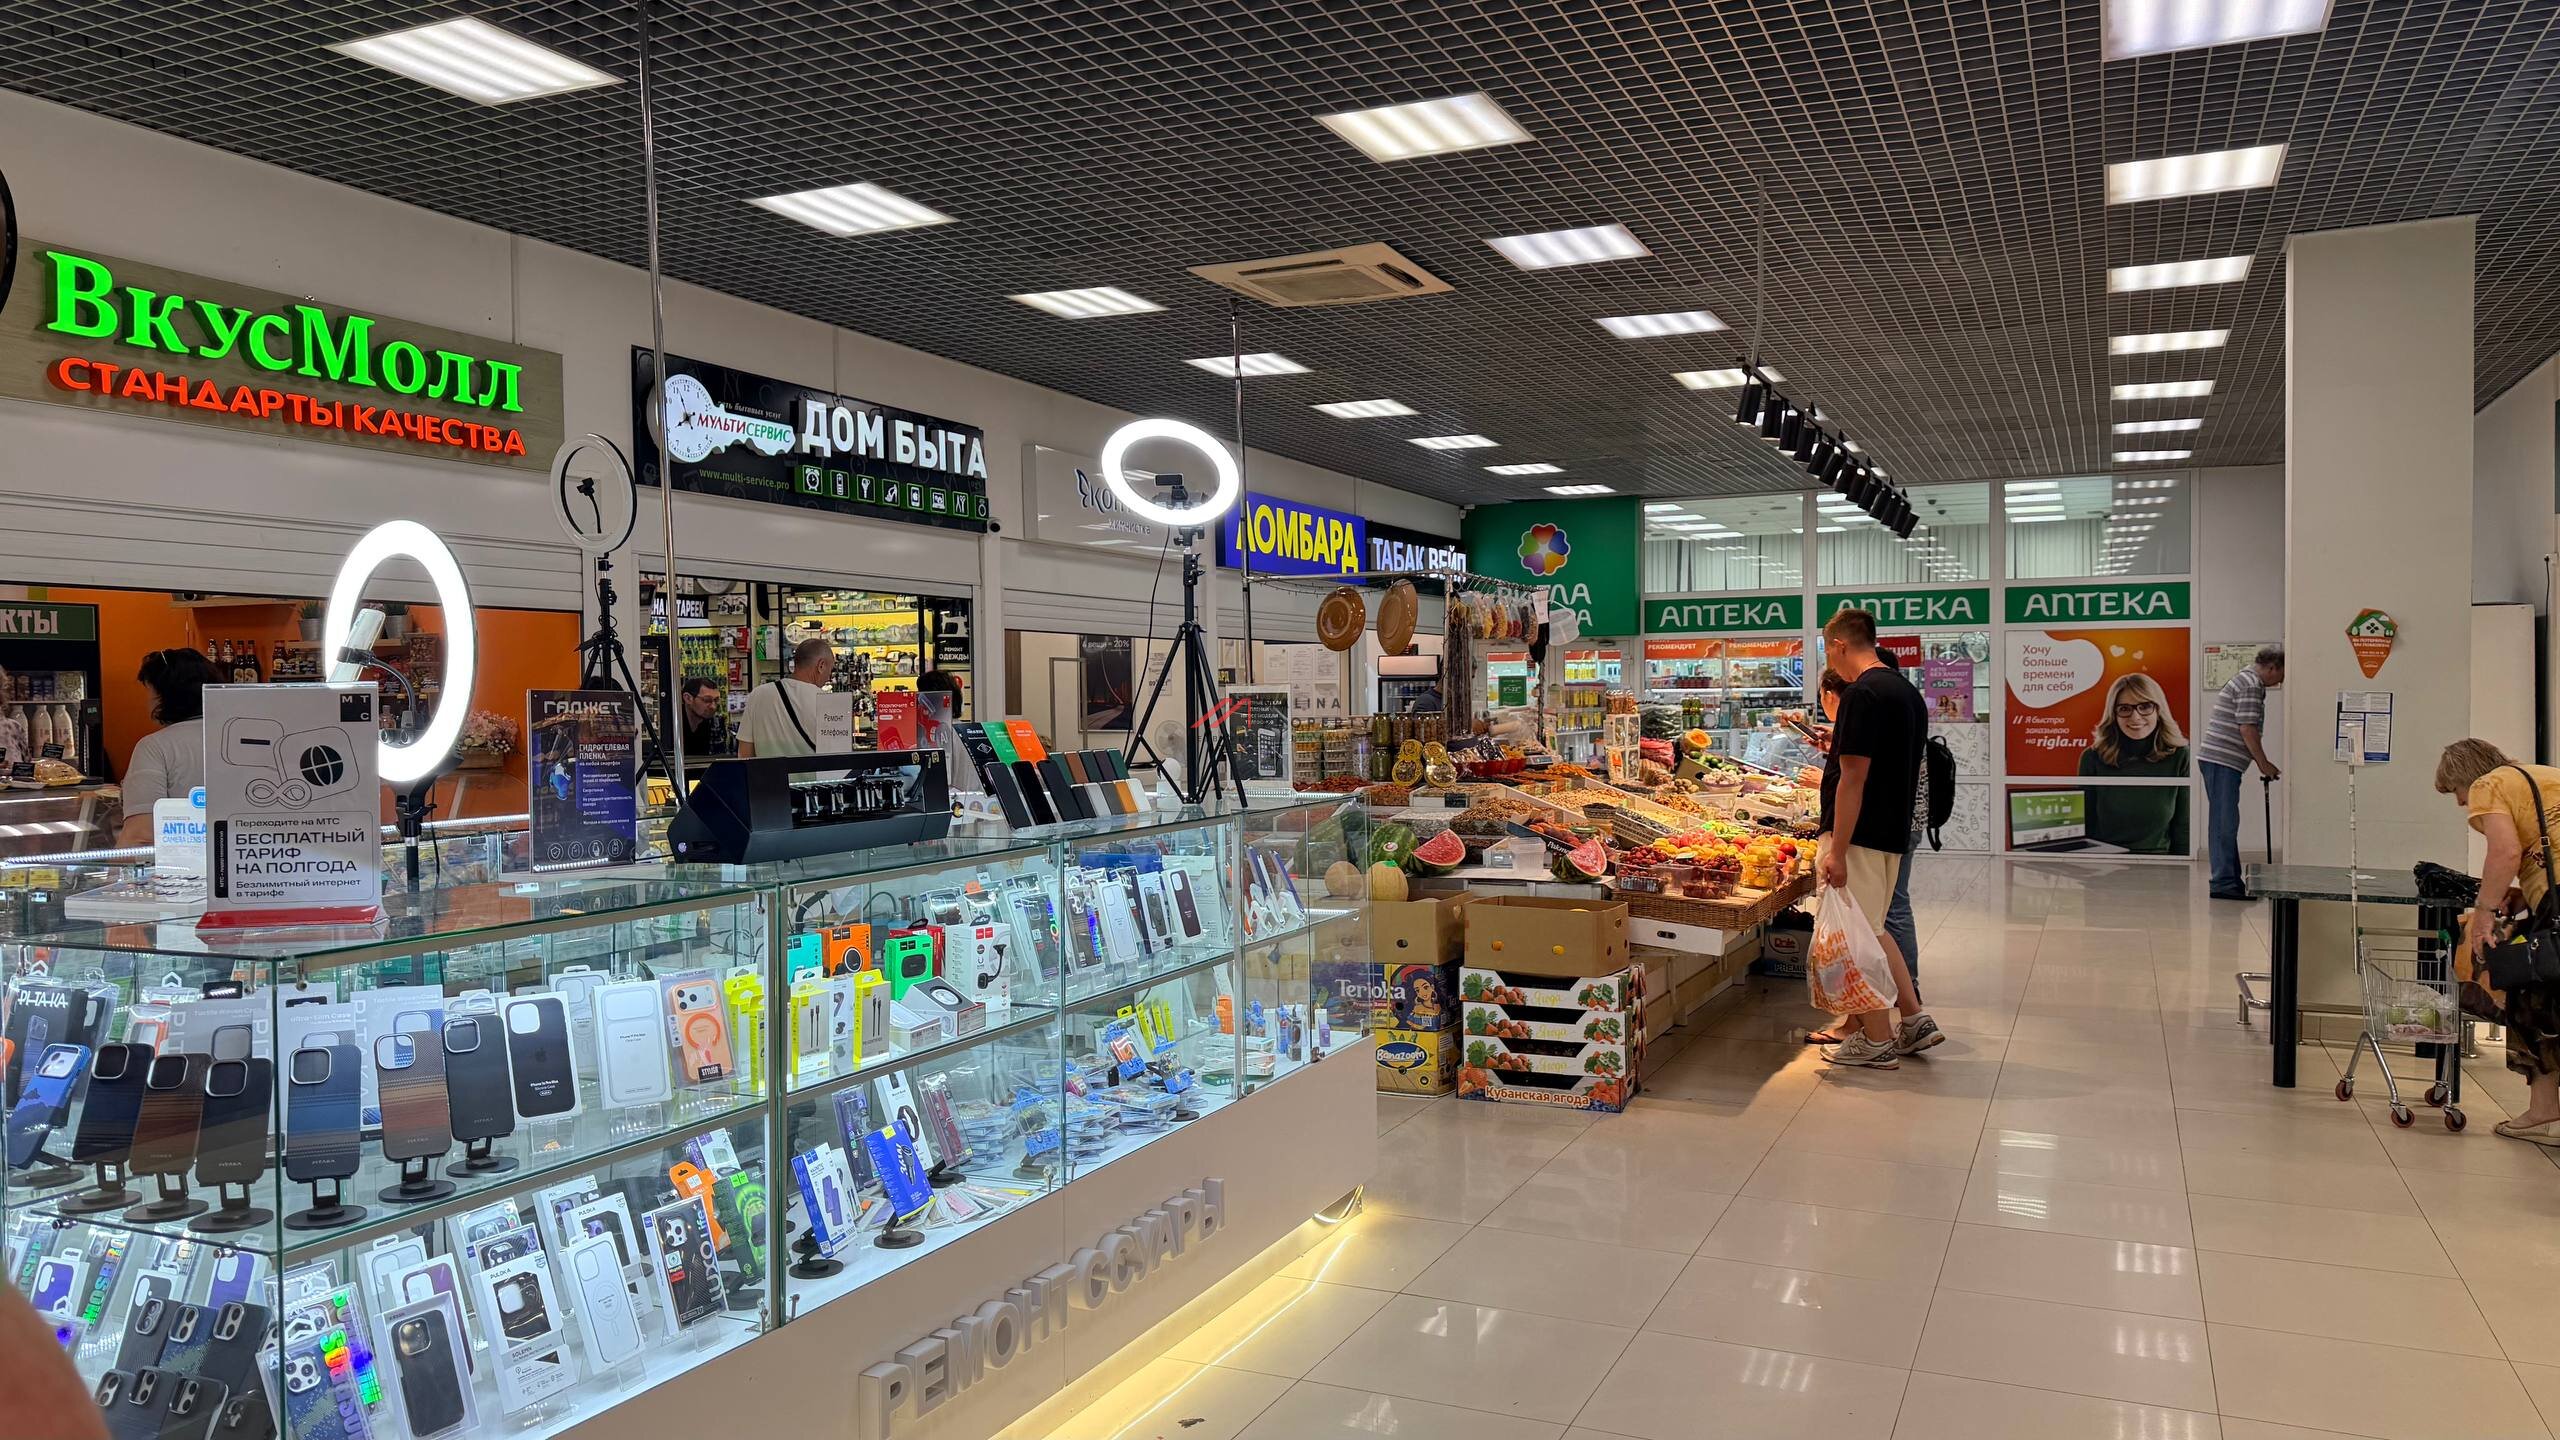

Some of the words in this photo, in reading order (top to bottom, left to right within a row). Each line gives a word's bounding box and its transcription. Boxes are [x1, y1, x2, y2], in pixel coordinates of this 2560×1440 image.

[59, 358, 343, 430] СТАНДАРТЫ
[354, 404, 526, 456] КАЧЕСТВА
[697, 413, 791, 443] МУЛЬТИСЕРВИС
[802, 400, 884, 459] ДОМ
[895, 420, 988, 479] БЫТА
[700, 469, 790, 490] www.multi-service.pro
[1236, 501, 1358, 574] ЛОМБАРД
[1373, 538, 1424, 571] ТАБАК
[1429, 545, 1467, 582] ВЕЙП
[666, 599, 704, 618] ТАРЕЕК
[1837, 597, 1974, 620] АПТЕКА
[2024, 591, 2173, 617] АПТЕКА
[1659, 602, 1787, 628] АПТЕКА
[1113, 639, 1130, 648] 20%
[1729, 641, 1780, 649] РЕКОМЕНДУЕТ
[939, 653, 969, 661] ОДЕЖДЫ
[2023, 645, 2051, 656] Хочу
[2023, 657, 2067, 666] больше
[2023, 671, 2074, 680] времени
[2023, 683, 2044, 693] для
[2047, 682, 2073, 691] себя
[543, 701, 622, 715] ГАДЖЕТ
[824, 714, 844, 722] Ремонт
[579, 744, 630, 752] ГИДРОГЕЛЕВАЯ
[2037, 736, 2087, 749] rigla.ru
[163, 823, 186, 834] ANTI
[236, 819, 299, 828] Переходите
[316, 818, 340, 826] МТС
[236, 828, 365, 845] БЕСПЛАТНЫЙ
[236, 848, 301, 860] ТАРИФ
[236, 863, 261, 874] НА
[266, 860, 357, 874] ПОЛГОДА
[236, 879, 310, 889] Безлимитный
[244, 890, 285, 898] тарифе
[354, 1000, 369, 1099] PITAKA
[1376, 1048, 1425, 1061] Banazoom
[1485, 1086, 1550, 1102] Кубанская
[1553, 1093, 1590, 1107] ягода
